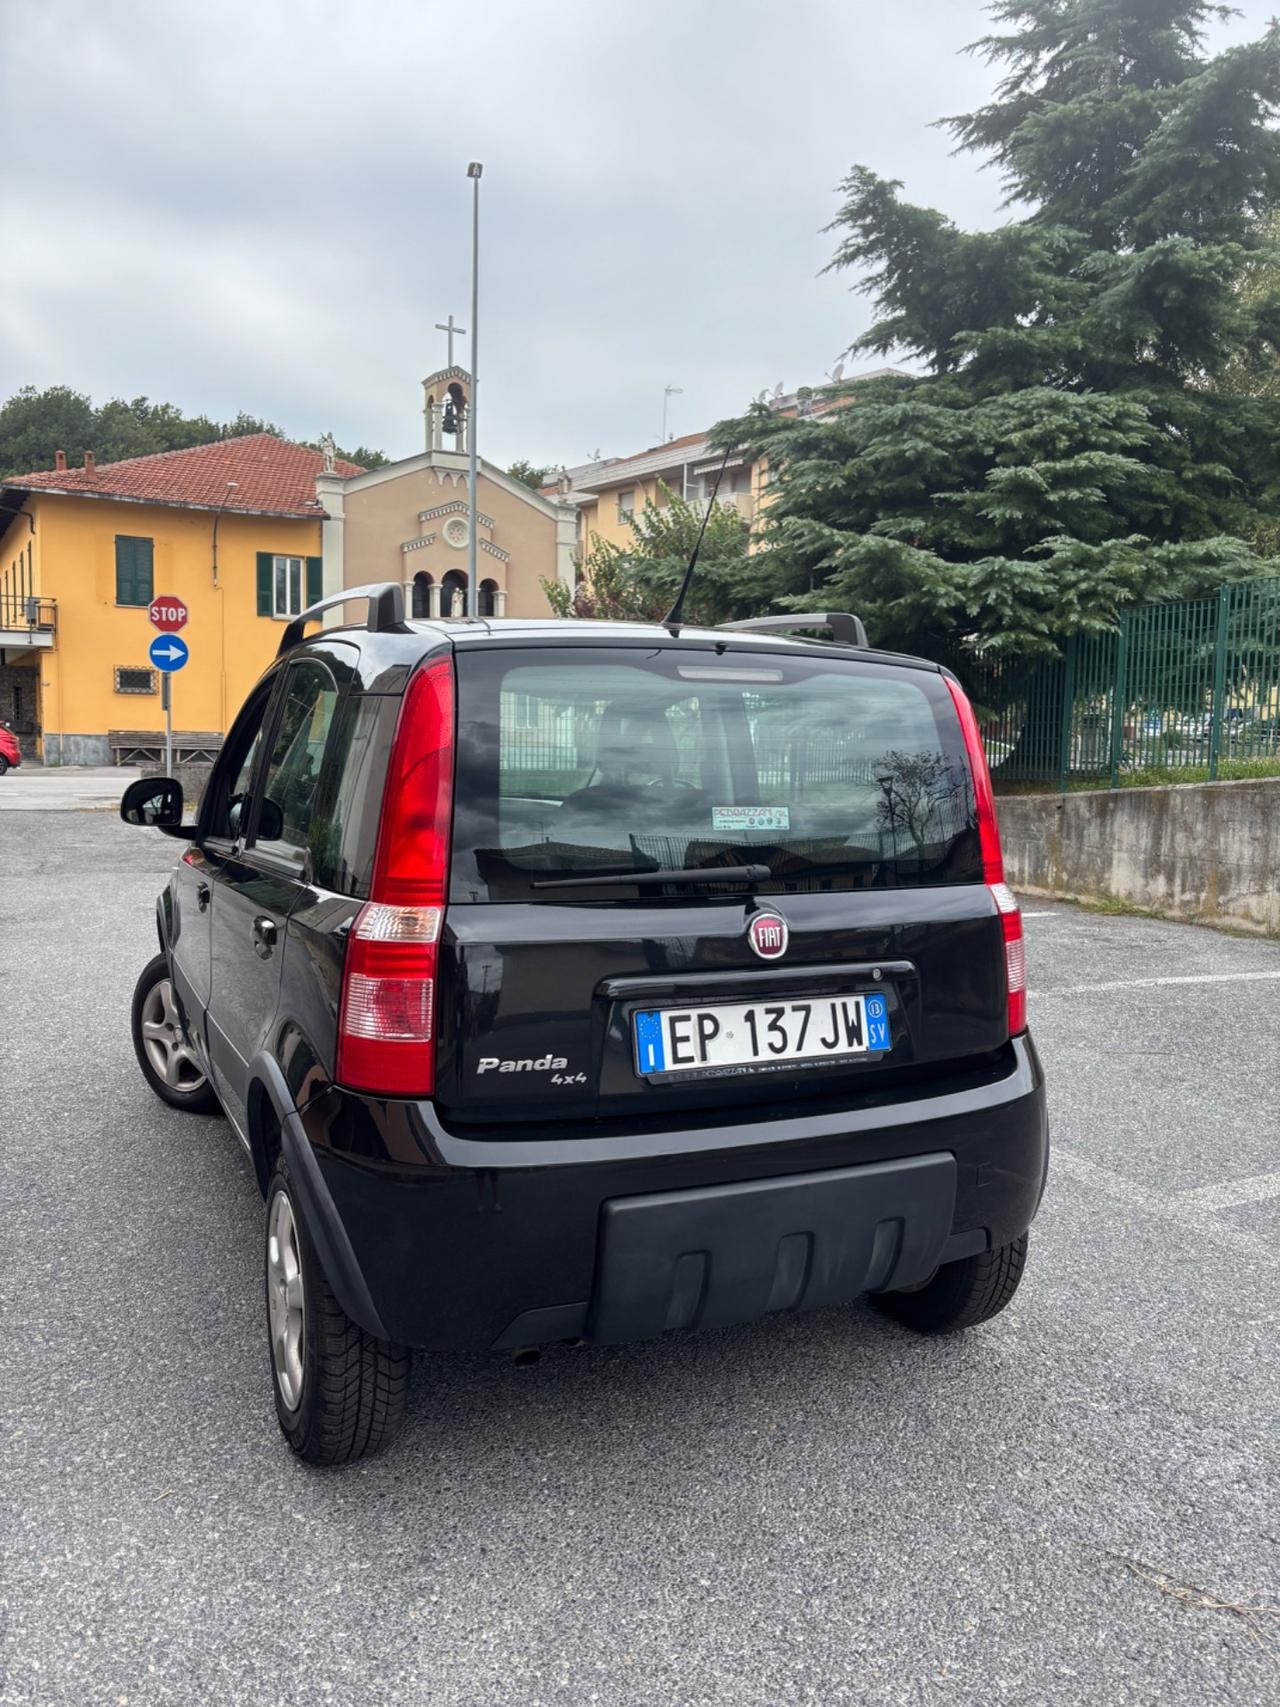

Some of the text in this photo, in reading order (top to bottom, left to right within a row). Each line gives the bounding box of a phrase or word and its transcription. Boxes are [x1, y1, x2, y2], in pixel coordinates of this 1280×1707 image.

[151, 606, 186, 621] STOP
[758, 927, 780, 947] FIAT
[668, 1013, 720, 1065] EP
[870, 1023, 886, 1044] SV
[476, 1054, 568, 1074] Panda
[550, 1072, 587, 1085] 4x4
